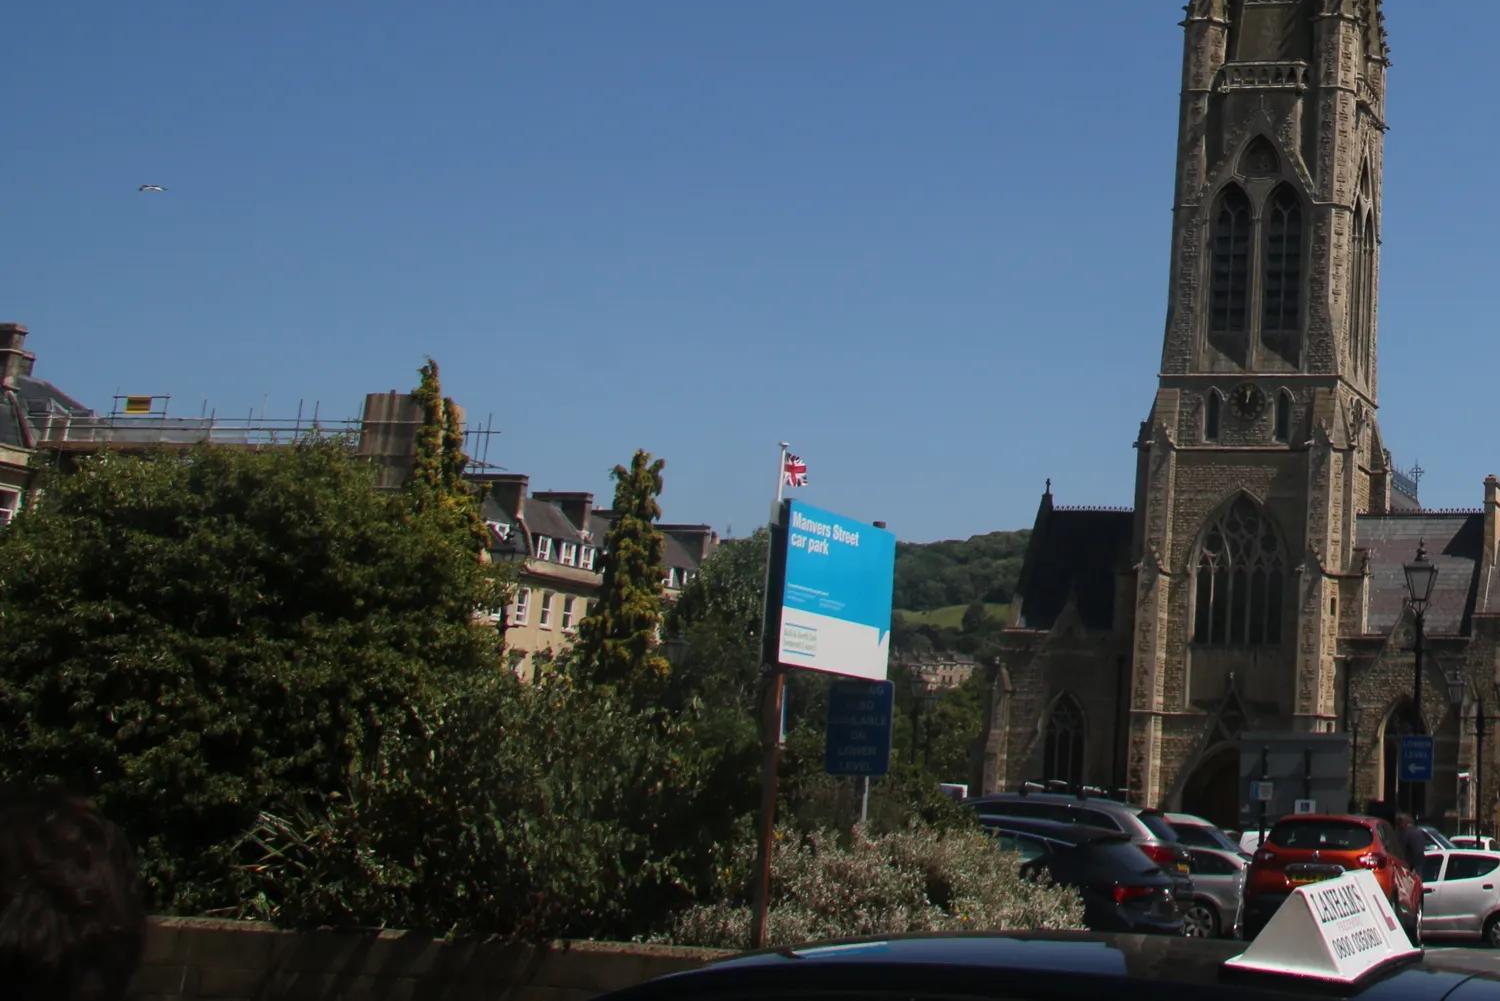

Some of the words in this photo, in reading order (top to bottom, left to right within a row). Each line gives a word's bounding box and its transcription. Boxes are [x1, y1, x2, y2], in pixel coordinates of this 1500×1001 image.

[792, 511, 831, 538] Manvers
[832, 524, 859, 546] Street
[791, 533, 807, 548] car
[808, 538, 829, 555] park
[1332, 936, 1356, 960] 0800
